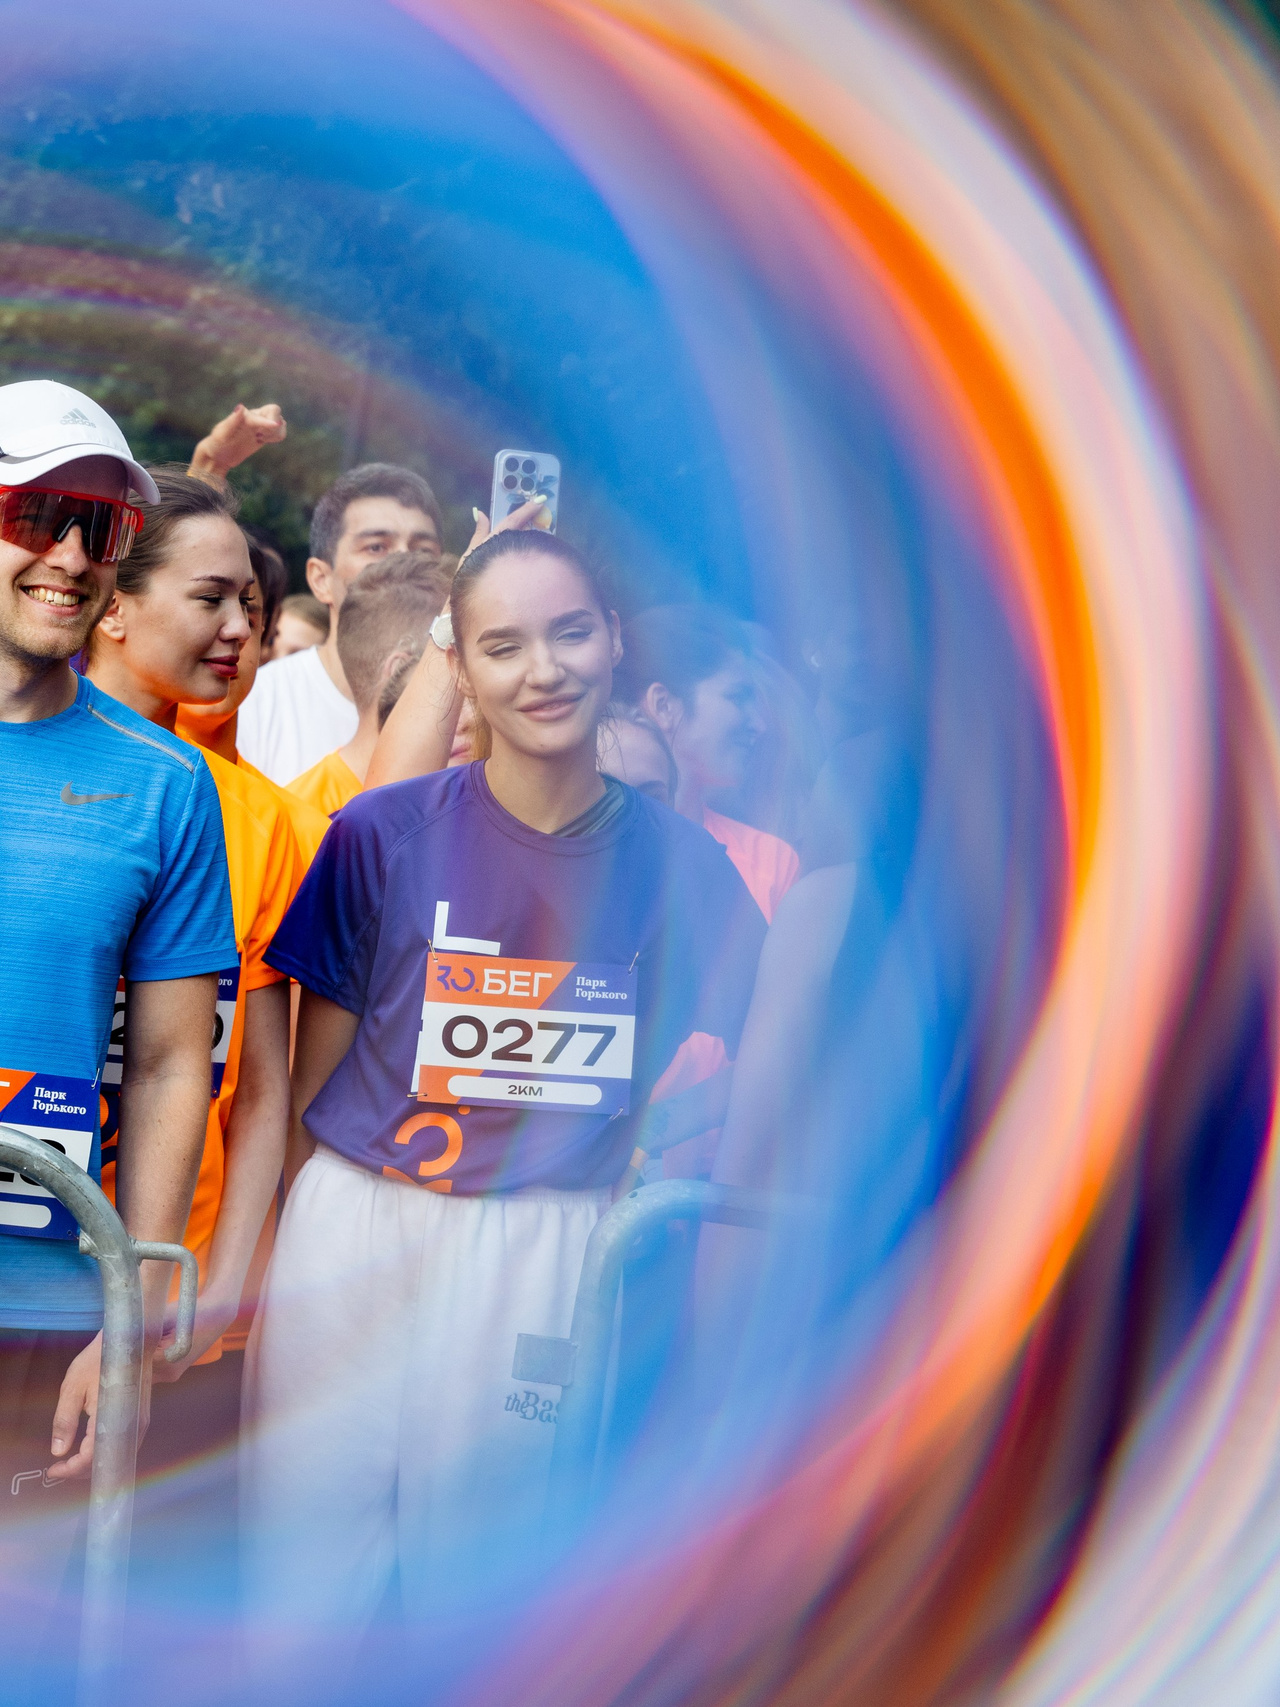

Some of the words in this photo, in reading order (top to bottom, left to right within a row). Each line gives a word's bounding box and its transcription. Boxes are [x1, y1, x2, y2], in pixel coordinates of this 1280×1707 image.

[60, 417, 96, 428] adidas
[576, 976, 607, 988] Парк
[575, 988, 628, 1001] Горького
[441, 1015, 617, 1067] 0277
[34, 1087, 67, 1101] Парк
[32, 1099, 87, 1115] Горького
